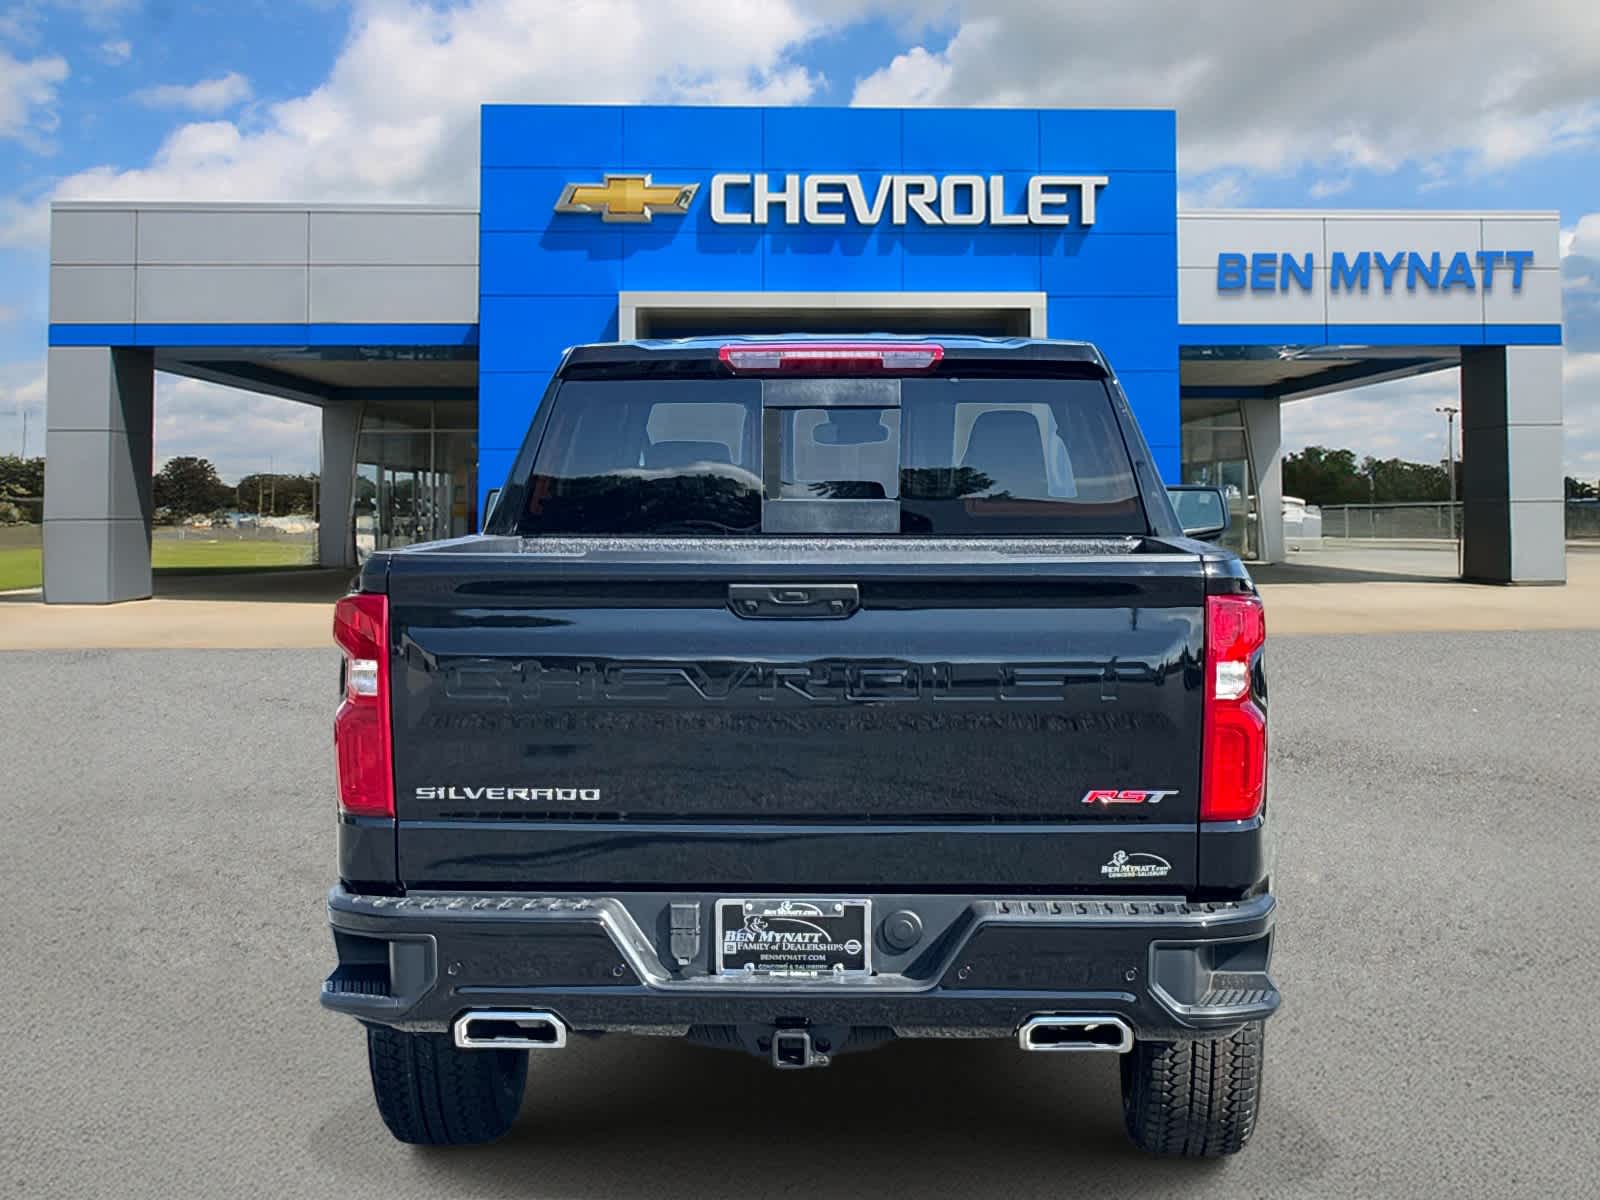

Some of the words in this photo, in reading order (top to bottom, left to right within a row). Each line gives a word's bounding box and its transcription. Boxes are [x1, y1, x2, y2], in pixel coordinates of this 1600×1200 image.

[710, 173, 1109, 224] CHEVROLET
[1217, 252, 1313, 290] BEN
[1330, 250, 1534, 290] MYNATT
[444, 659, 1150, 701] CHEVROLET
[415, 786, 600, 801] SILVERADO
[1081, 790, 1180, 803] RST
[724, 930, 756, 942] BEN
[758, 931, 823, 943] MYNATT
[737, 942, 770, 951] FAMILY
[771, 942, 780, 951] of
[782, 942, 844, 952] DEALERSHIPS
